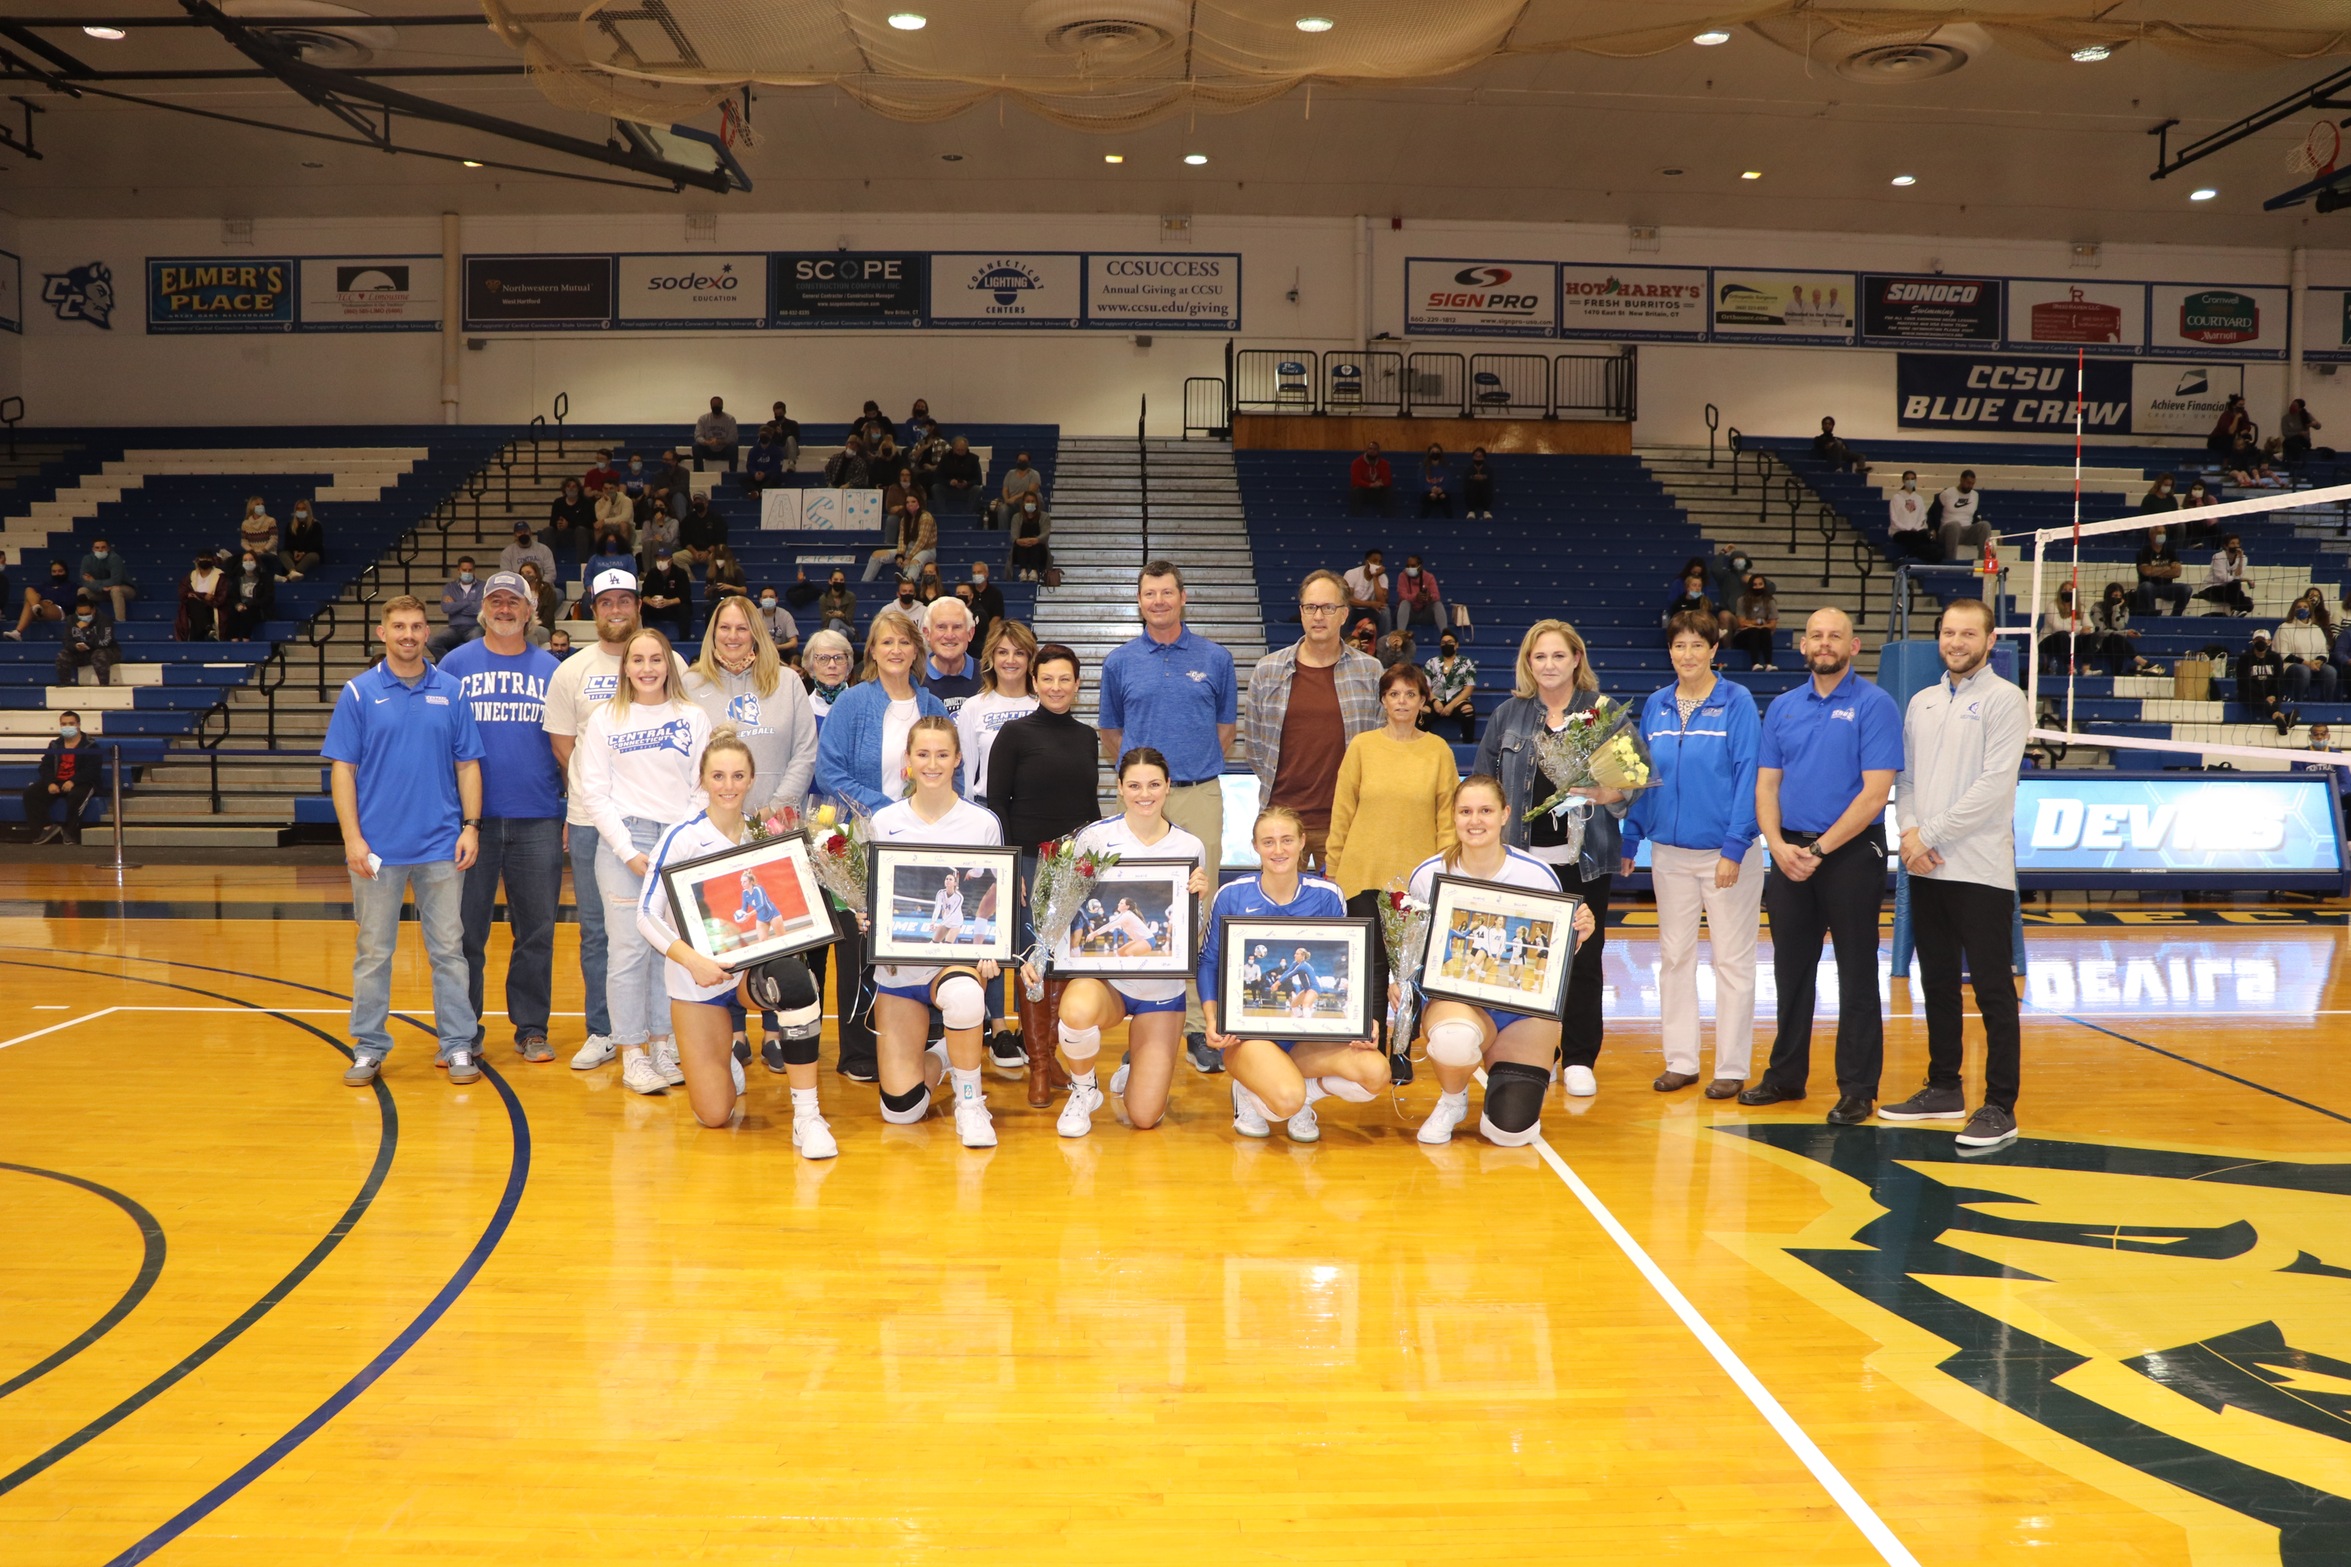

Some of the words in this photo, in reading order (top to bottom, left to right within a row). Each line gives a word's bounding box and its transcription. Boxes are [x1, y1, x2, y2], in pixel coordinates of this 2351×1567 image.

[796, 260, 902, 280] SCOPE
[968, 259, 1044, 290] CONNECTICUT
[1106, 261, 1219, 276] CCSUCCESS
[161, 267, 283, 295] ELMER'S
[502, 284, 559, 292] Northwestern
[561, 283, 591, 291] Mutual
[648, 272, 738, 290] sodexo
[796, 282, 849, 290] CONSTRUCTION
[851, 282, 886, 290] COMPANY
[984, 277, 1028, 288] LIGHTING
[1102, 285, 1138, 294] Annual
[1142, 285, 1176, 297] Giving
[1191, 285, 1223, 295] CCSU
[1566, 283, 1605, 295] HOT
[1617, 284, 1700, 298] HARRY'S
[1887, 283, 1978, 303] SONOCO
[171, 295, 274, 312] PLACE
[1428, 293, 1485, 308] SIGN
[1487, 294, 1538, 309] PRO
[1584, 299, 1620, 307] FRESH
[1624, 300, 1680, 309] BURRITOS
[2202, 295, 2239, 304] Cromwell
[1097, 301, 1229, 316] www.ccsu.edu/giving
[1911, 305, 1954, 316] Swimming
[2187, 315, 2252, 328] COURTYARD
[2201, 332, 2237, 340] Marriott
[1966, 364, 2065, 391] CCSU
[1903, 395, 2006, 422] BLUE
[2013, 398, 2127, 425] CREW
[2151, 400, 2185, 410] Achieve
[609, 727, 673, 744] CENTRAL
[613, 736, 669, 749] CONNECTICUT
